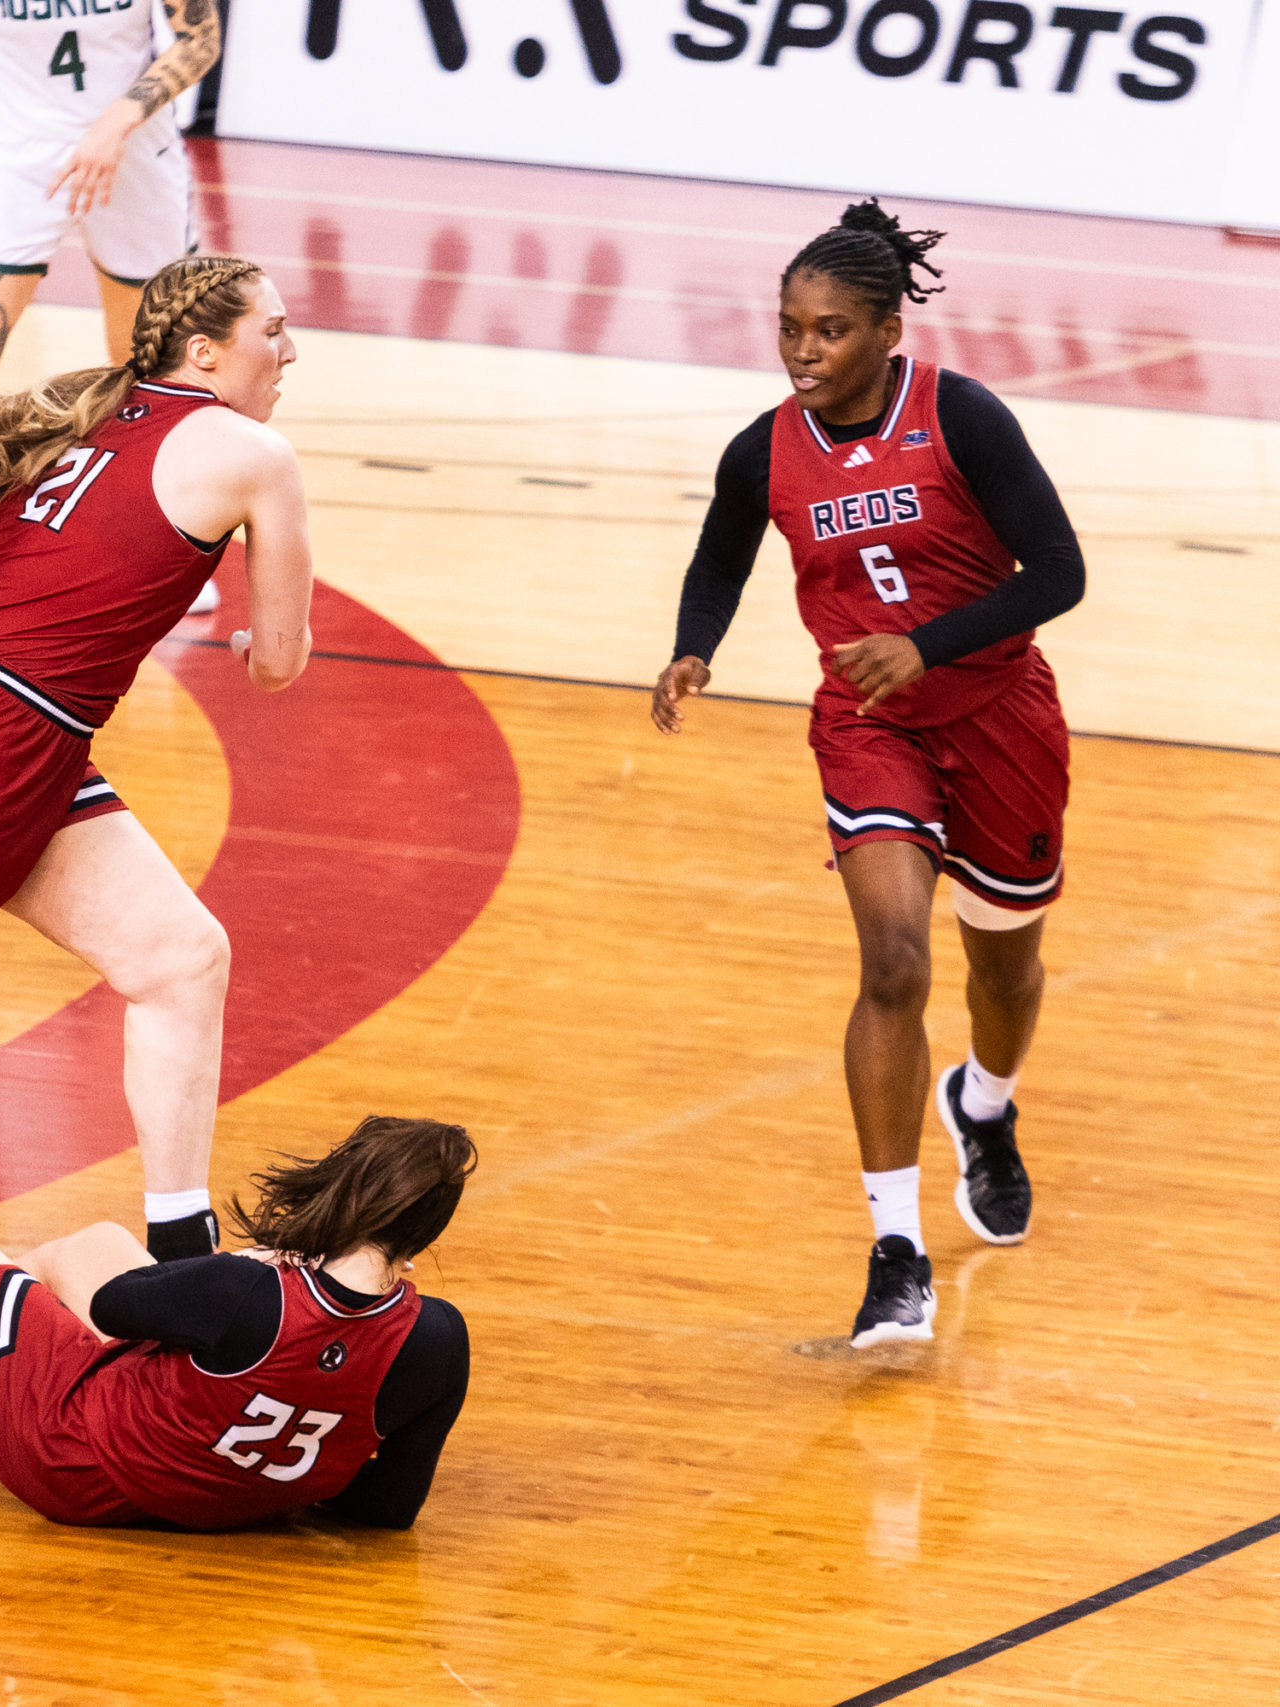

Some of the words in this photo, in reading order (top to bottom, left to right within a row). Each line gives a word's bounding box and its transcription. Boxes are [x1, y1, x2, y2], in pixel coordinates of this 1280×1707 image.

[48, 29, 86, 92] 4
[672, 0, 1208, 102] SPORTS
[17, 446, 118, 534] 21
[808, 484, 924, 541] REDS
[858, 542, 911, 606] 6
[211, 1392, 344, 1483] 23
